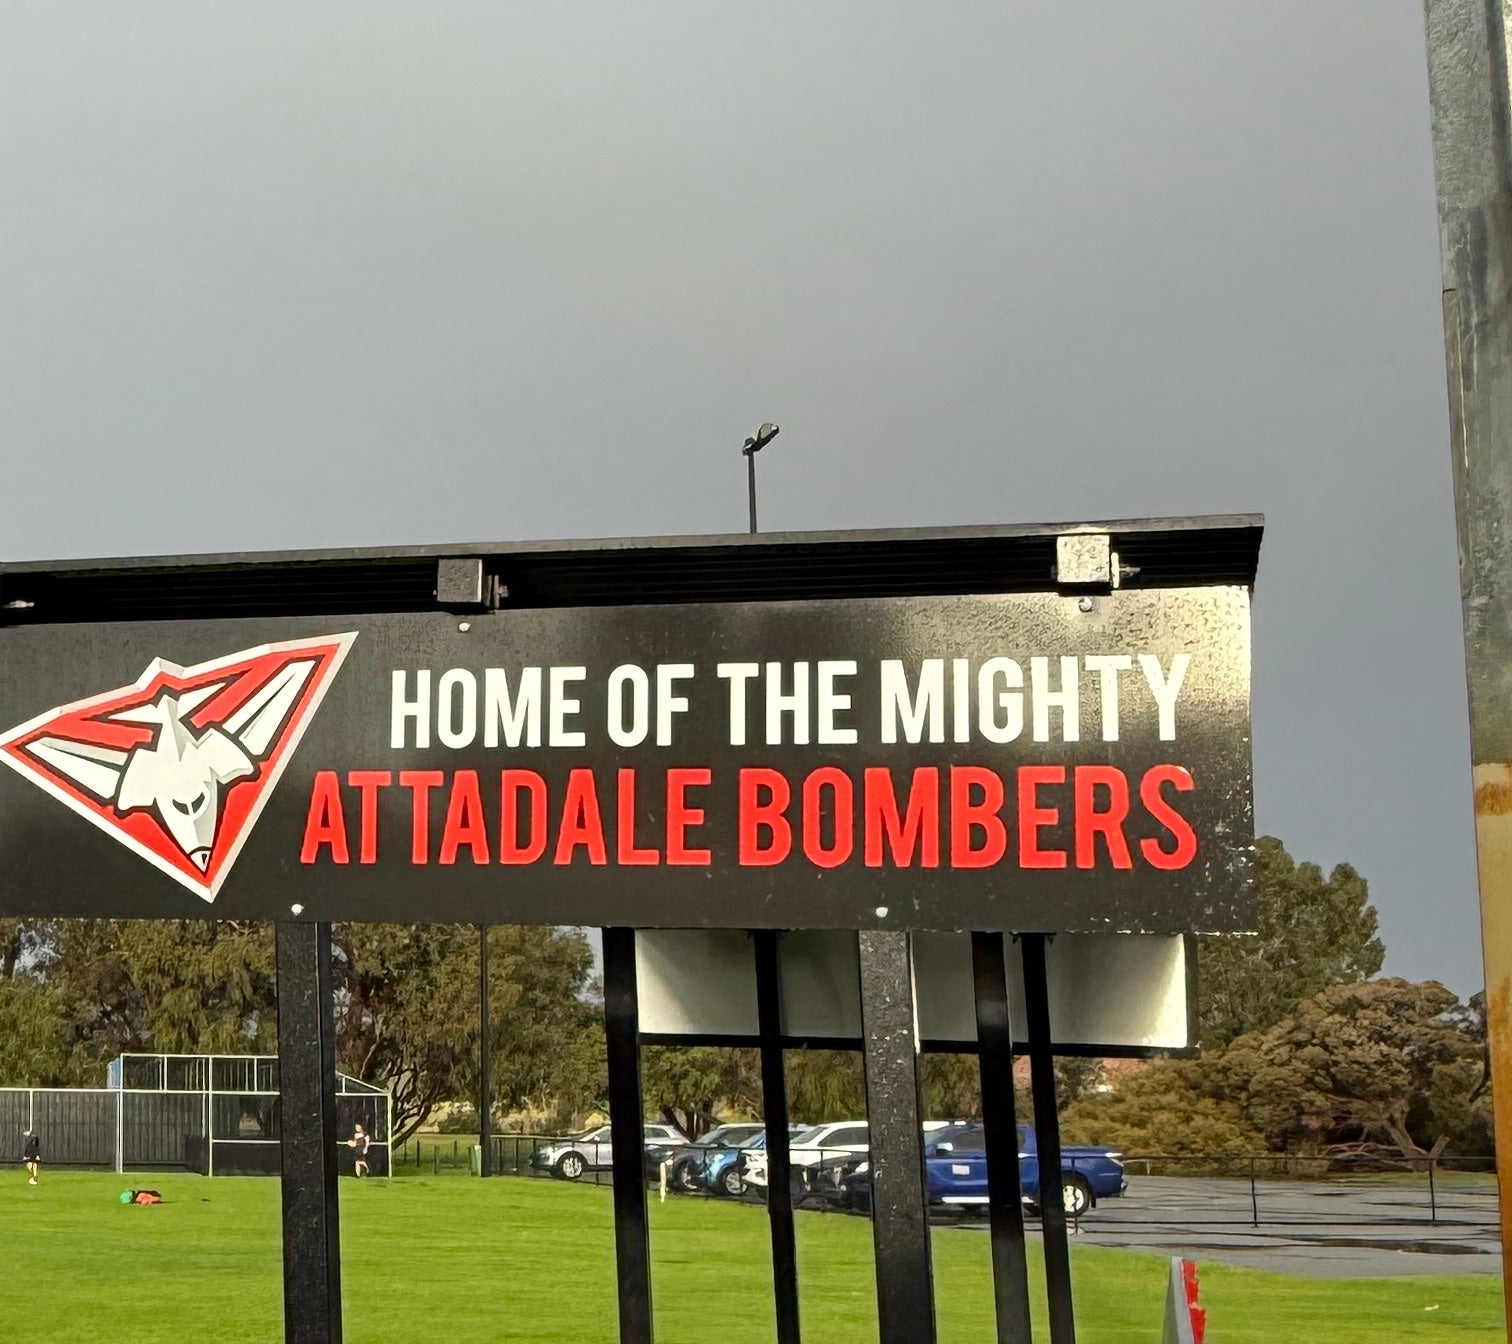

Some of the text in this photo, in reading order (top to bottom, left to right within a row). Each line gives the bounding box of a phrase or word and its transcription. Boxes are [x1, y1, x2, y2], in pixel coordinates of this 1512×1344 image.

[389, 652, 1191, 750] HOME OF THE MIGHTY
[299, 763, 1198, 872] ATTADALE BOMBERS
